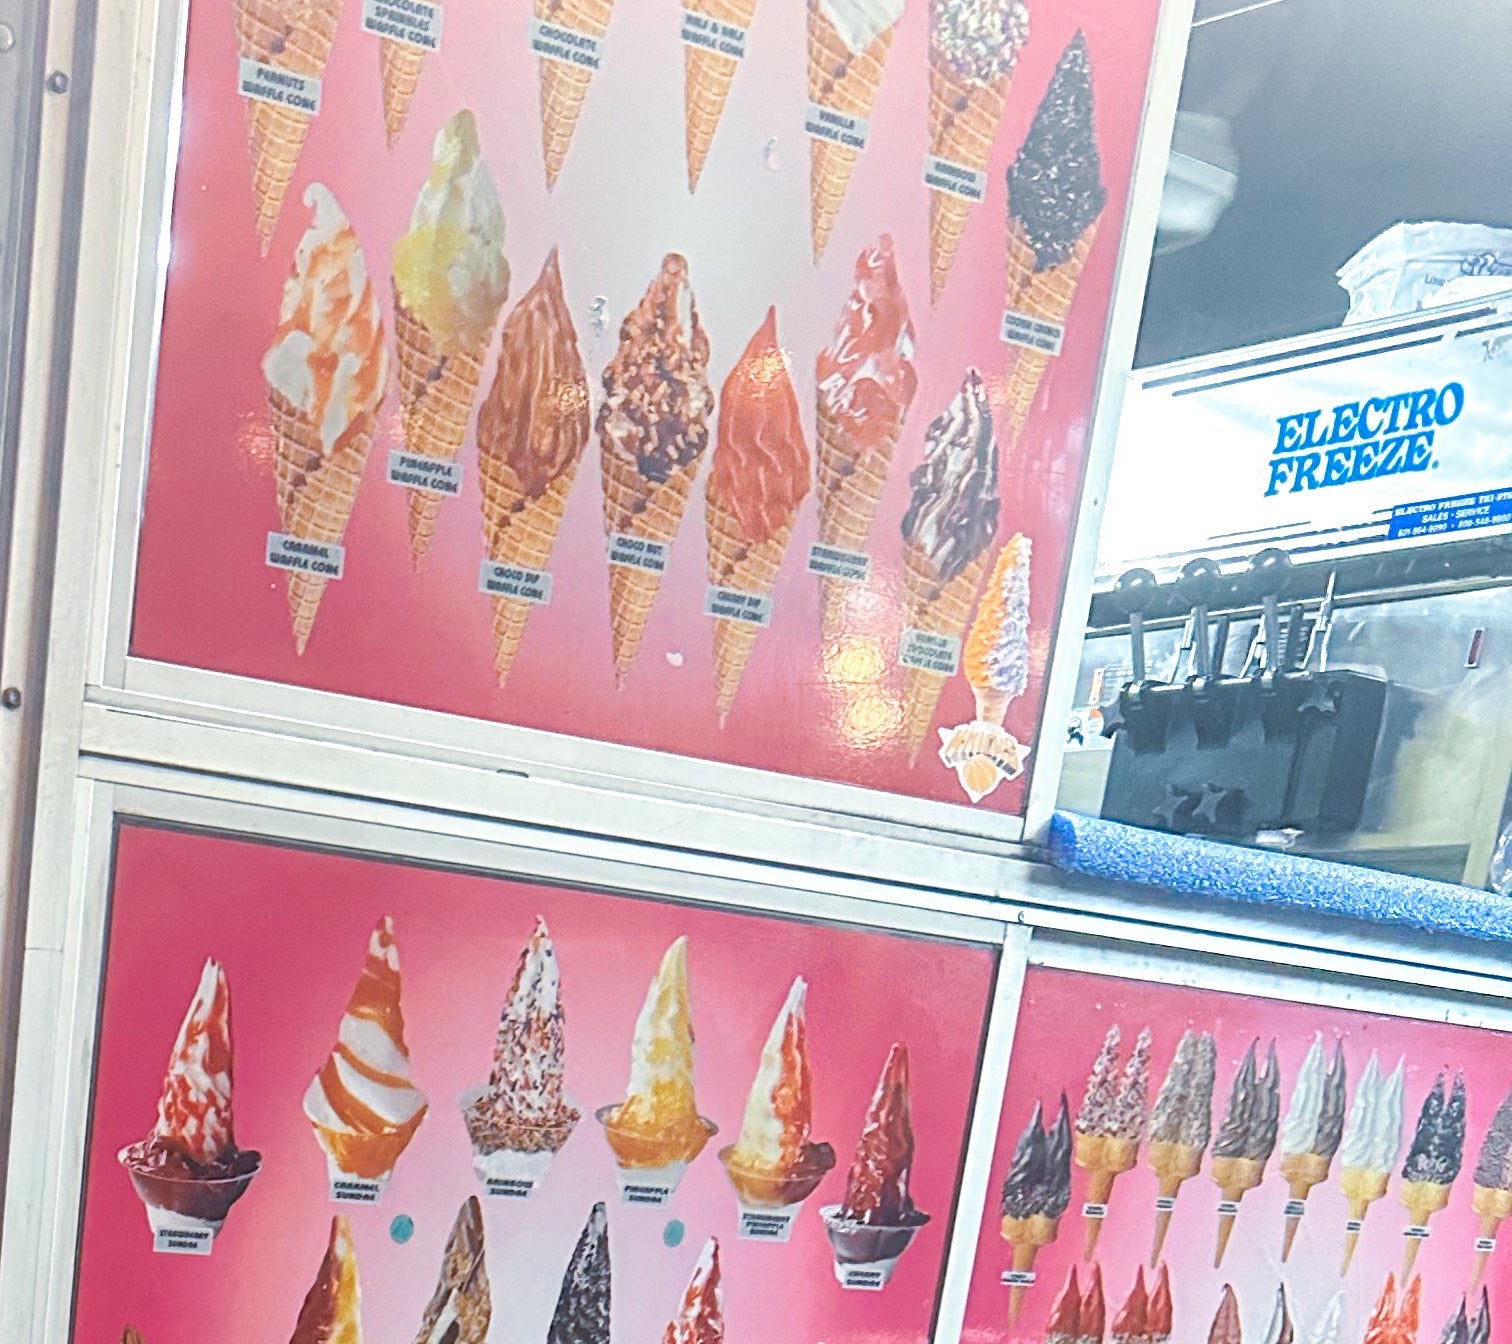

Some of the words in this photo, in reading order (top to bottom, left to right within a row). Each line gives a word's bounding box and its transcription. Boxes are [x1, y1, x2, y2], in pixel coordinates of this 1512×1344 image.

[407, 29, 436, 49] CONE
[539, 25, 597, 52] CHOCOLATE
[256, 66, 305, 91] PEANUTS
[242, 79, 284, 102] WAFFLE
[286, 92, 316, 112] CONE
[1272, 382, 1464, 454] ELECTRO
[399, 456, 452, 477] PINEAPPLE
[390, 468, 430, 488] WAFFLE
[431, 477, 458, 494] CONE
[282, 539, 330, 559] CARAMEL
[268, 553, 310, 572] WAFFLE
[311, 560, 339, 577] CONE
[493, 566, 522, 582] CHOCO
[334, 1182, 379, 1193] CARAMEL
[335, 1191, 376, 1201] SUNDAE
